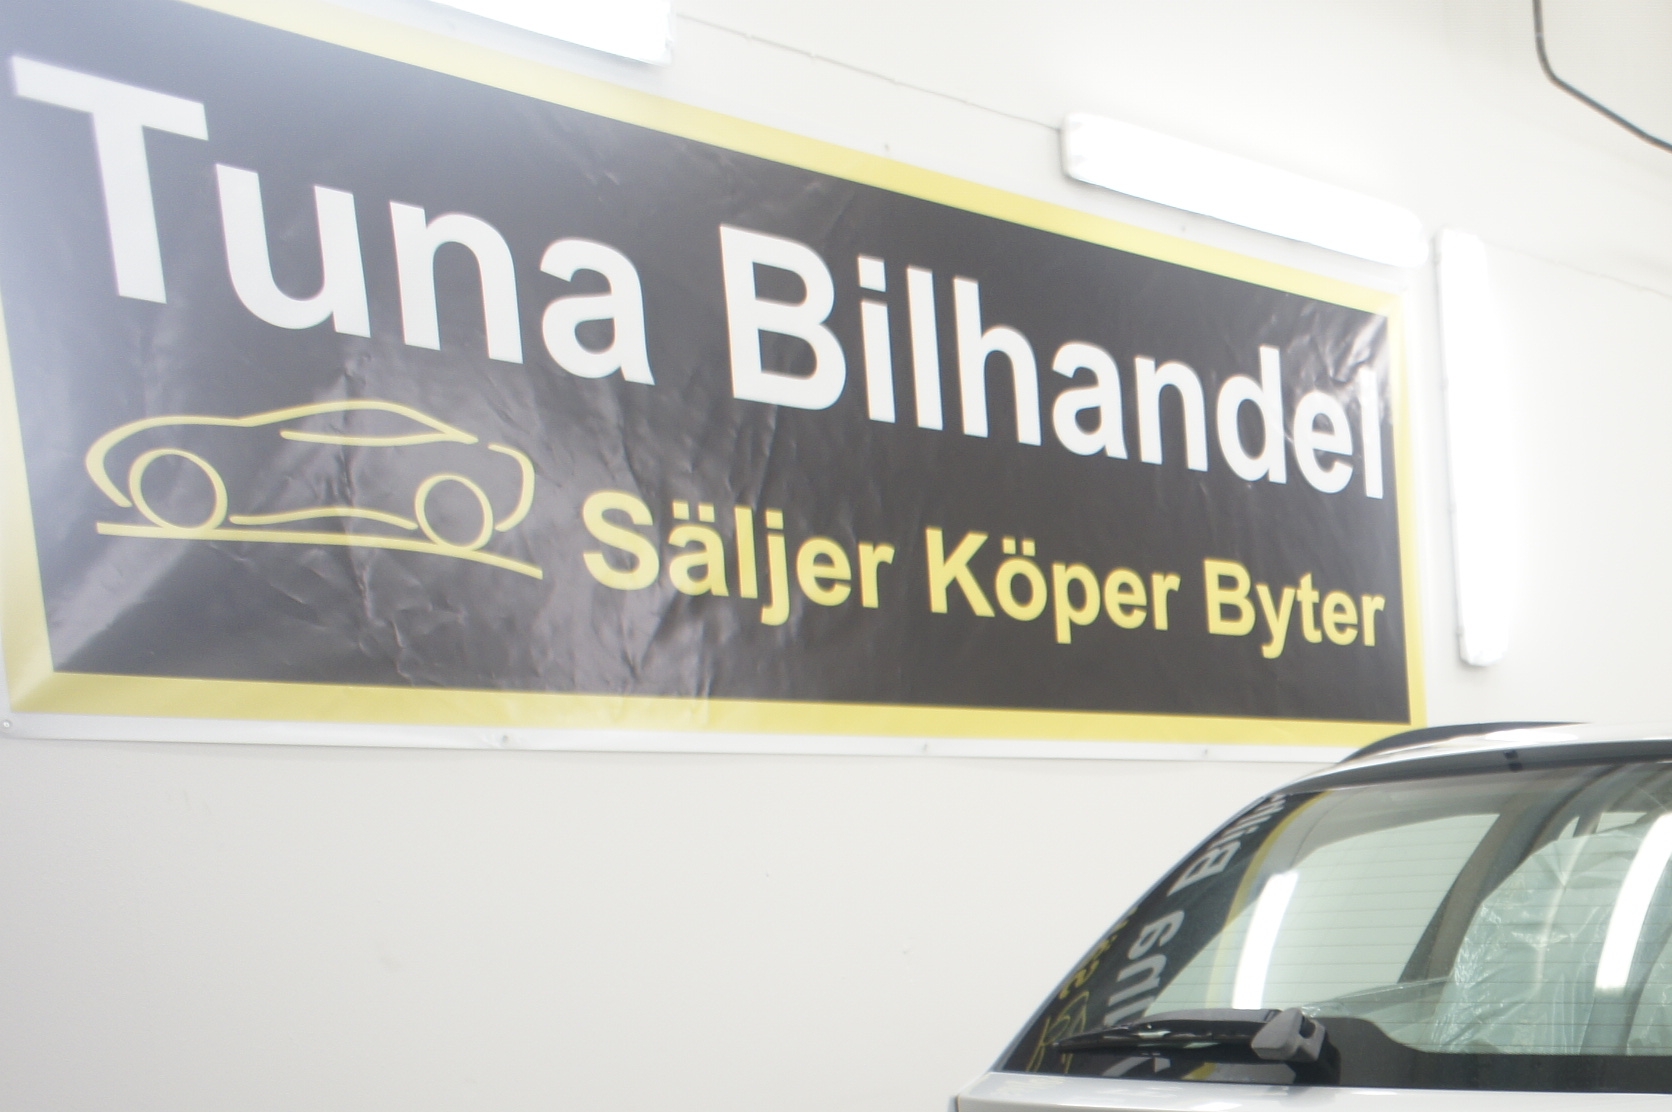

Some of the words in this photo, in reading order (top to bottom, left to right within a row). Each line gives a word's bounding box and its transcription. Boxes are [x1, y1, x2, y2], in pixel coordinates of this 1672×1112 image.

[11, 55, 656, 386] Tuna
[720, 223, 1385, 500] Bilhandel
[581, 489, 895, 626] Säljer
[925, 526, 1182, 645] Köper
[1203, 557, 1387, 660] Byter
